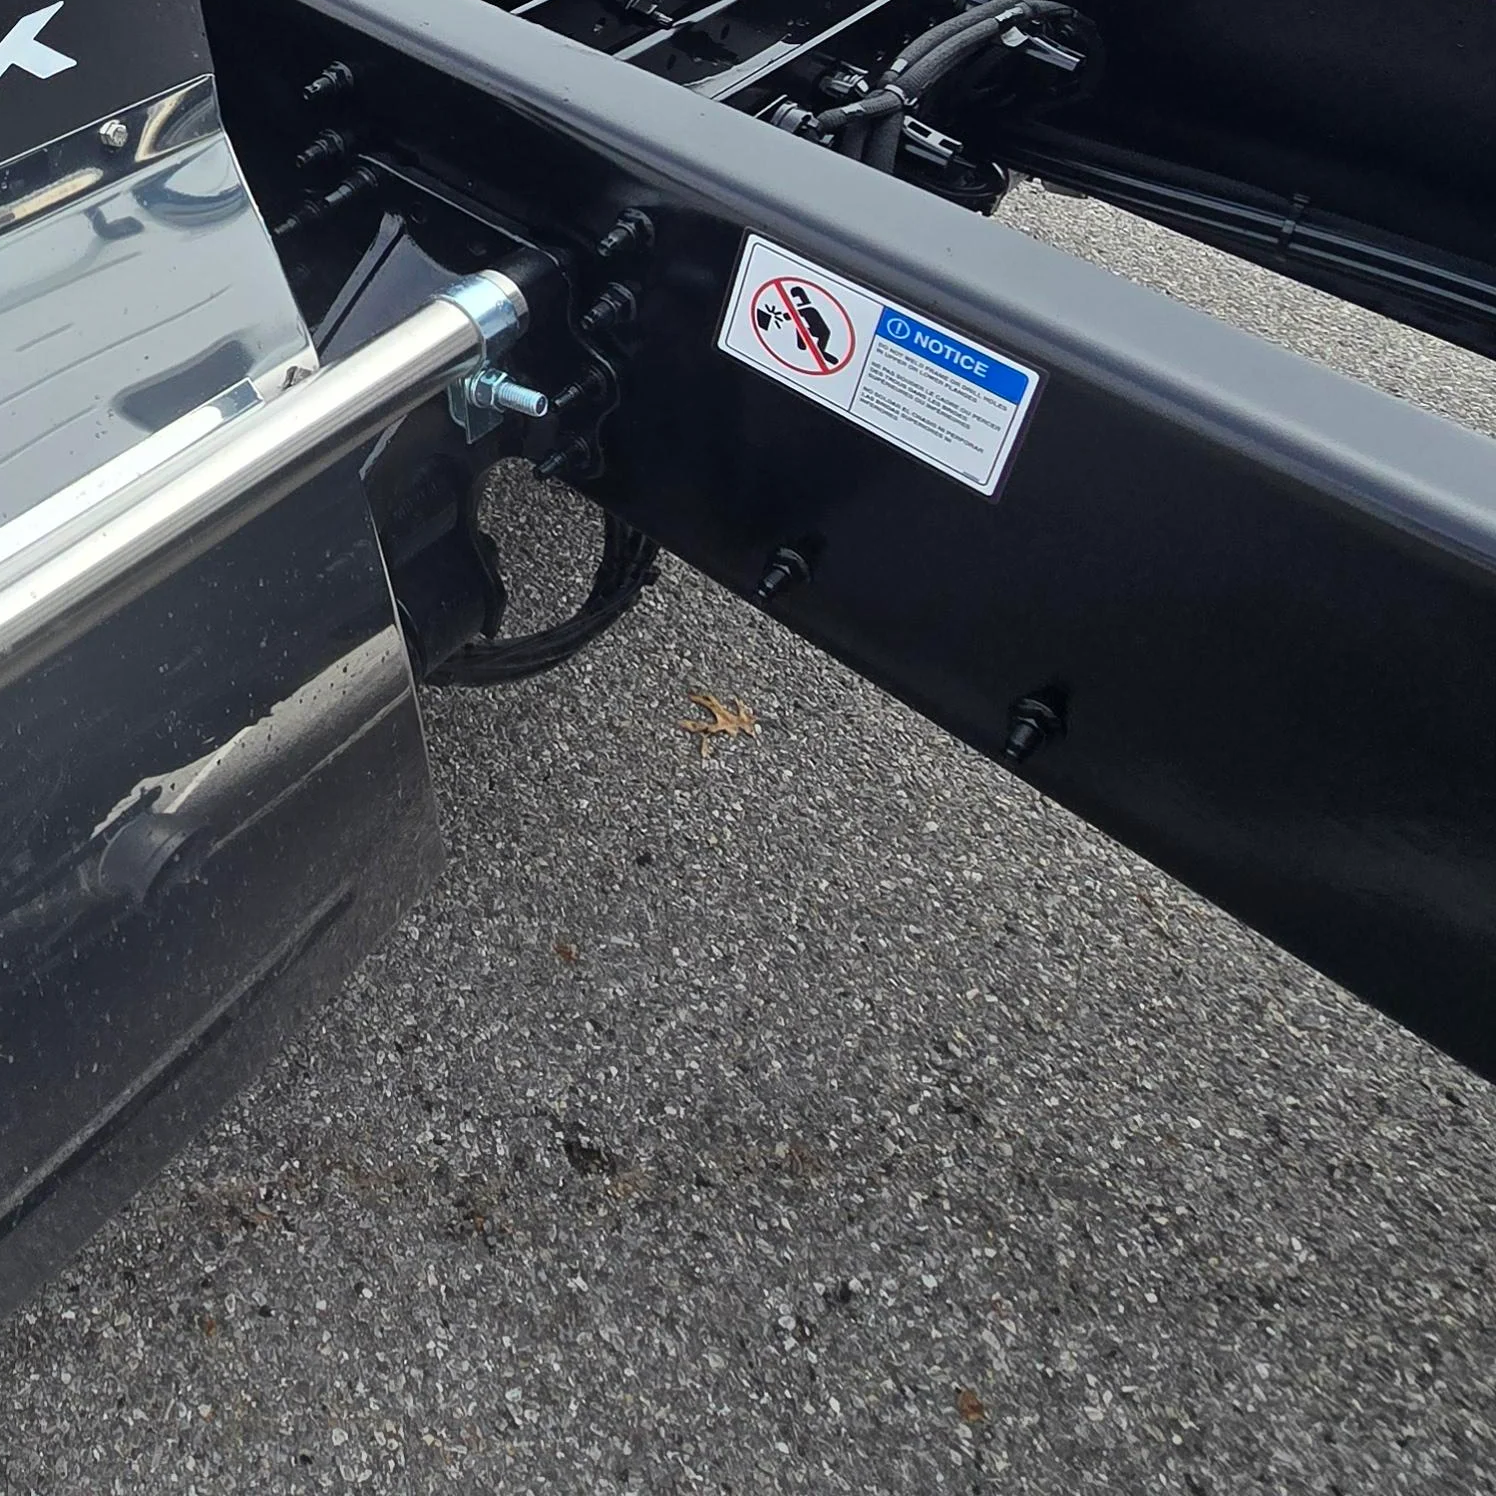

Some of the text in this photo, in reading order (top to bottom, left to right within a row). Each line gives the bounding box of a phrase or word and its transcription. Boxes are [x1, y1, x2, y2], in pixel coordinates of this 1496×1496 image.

[882, 366, 895, 376] PAS
[884, 352, 906, 366] UPPER
[919, 369, 944, 385] LOWER
[944, 382, 977, 402] FLANGES
[913, 331, 989, 377] NOTICE
[889, 348, 903, 357] NOT
[904, 355, 924, 368] WELD
[924, 365, 948, 380] FRAME
[983, 395, 1008, 410] HOLES
